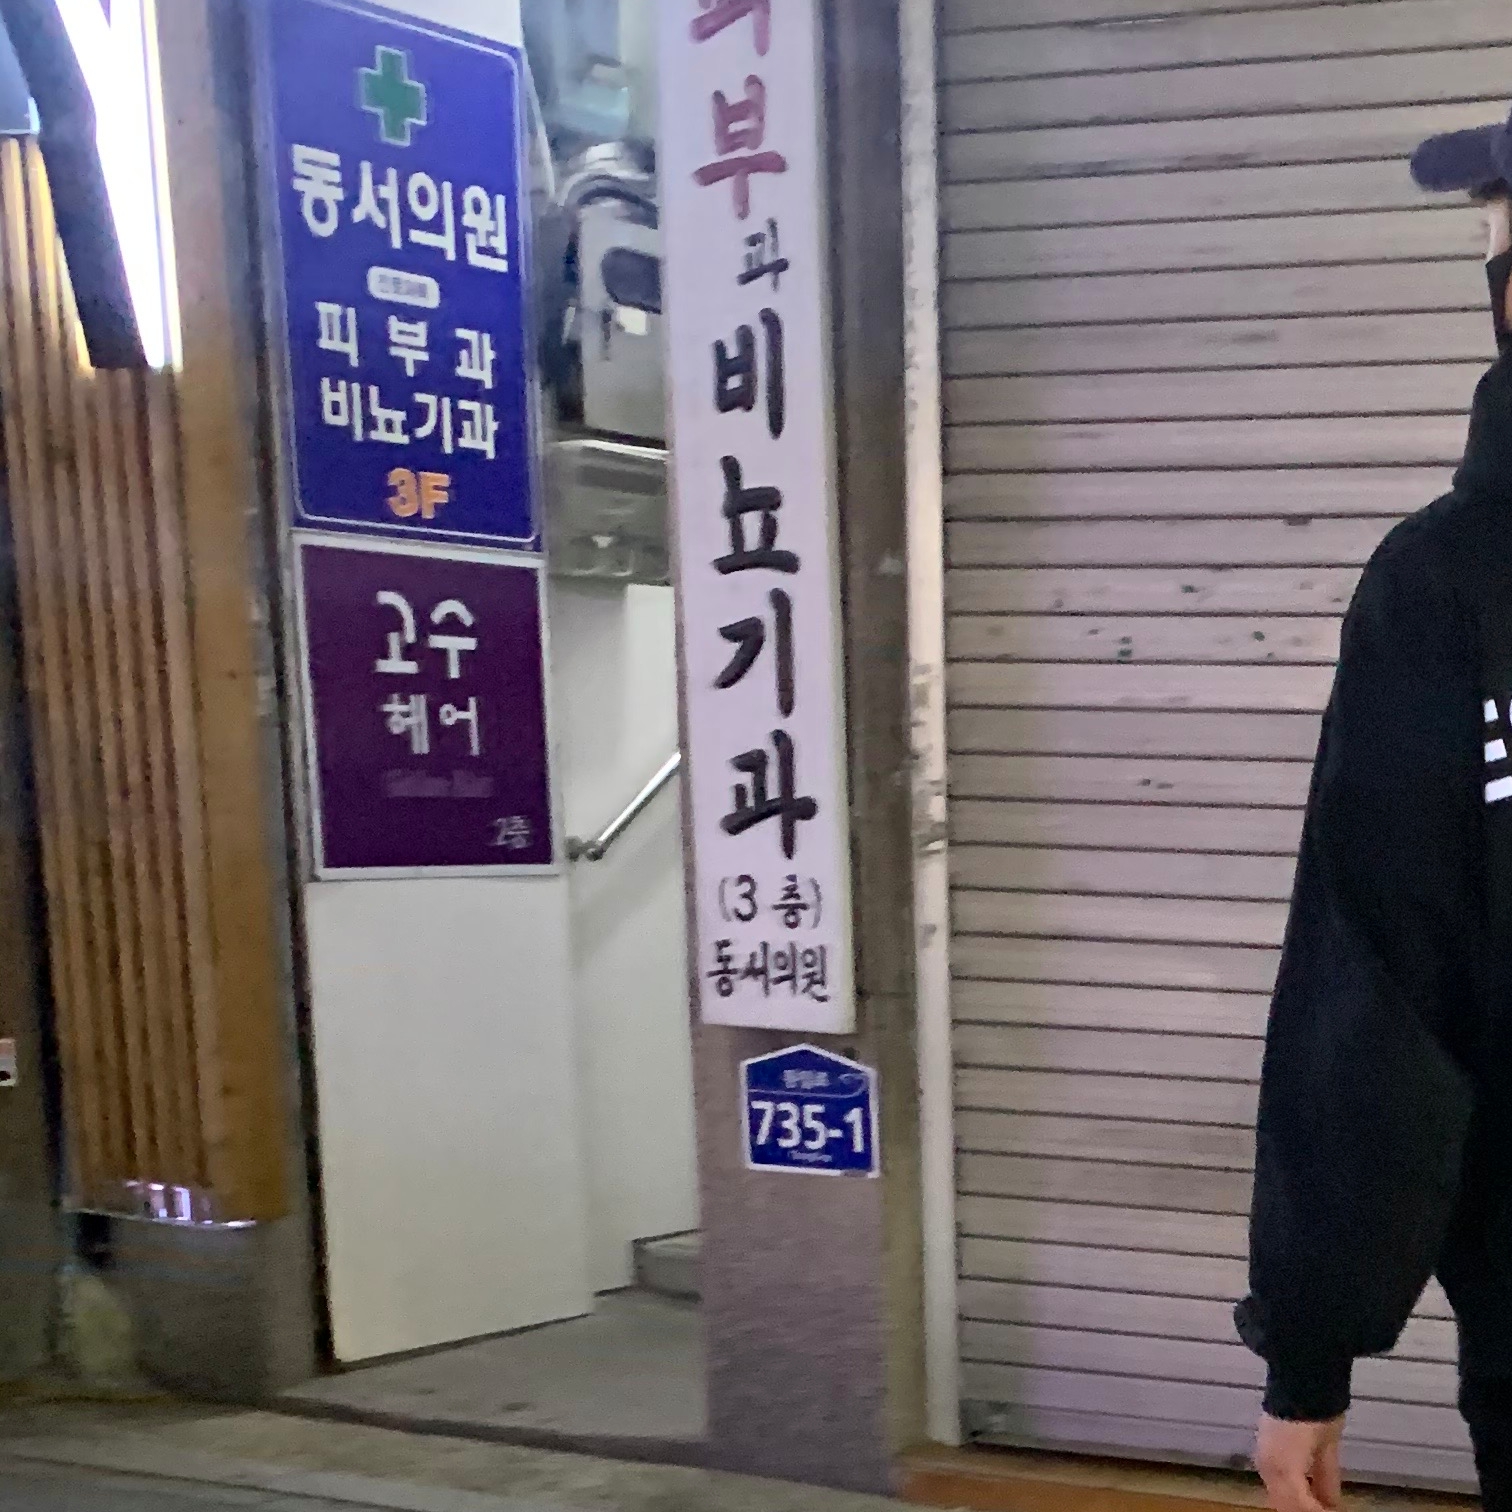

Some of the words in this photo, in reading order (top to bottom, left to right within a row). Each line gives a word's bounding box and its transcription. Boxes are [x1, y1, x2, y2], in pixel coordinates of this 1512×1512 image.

[292, 143, 508, 273] 동서의원
[321, 377, 498, 459] 비뇨기과
[387, 467, 450, 519] 3F
[375, 590, 478, 679] 고수
[380, 694, 480, 756] 헤어
[706, 939, 831, 1002] 동서의원
[750, 1100, 864, 1153] 735-1
